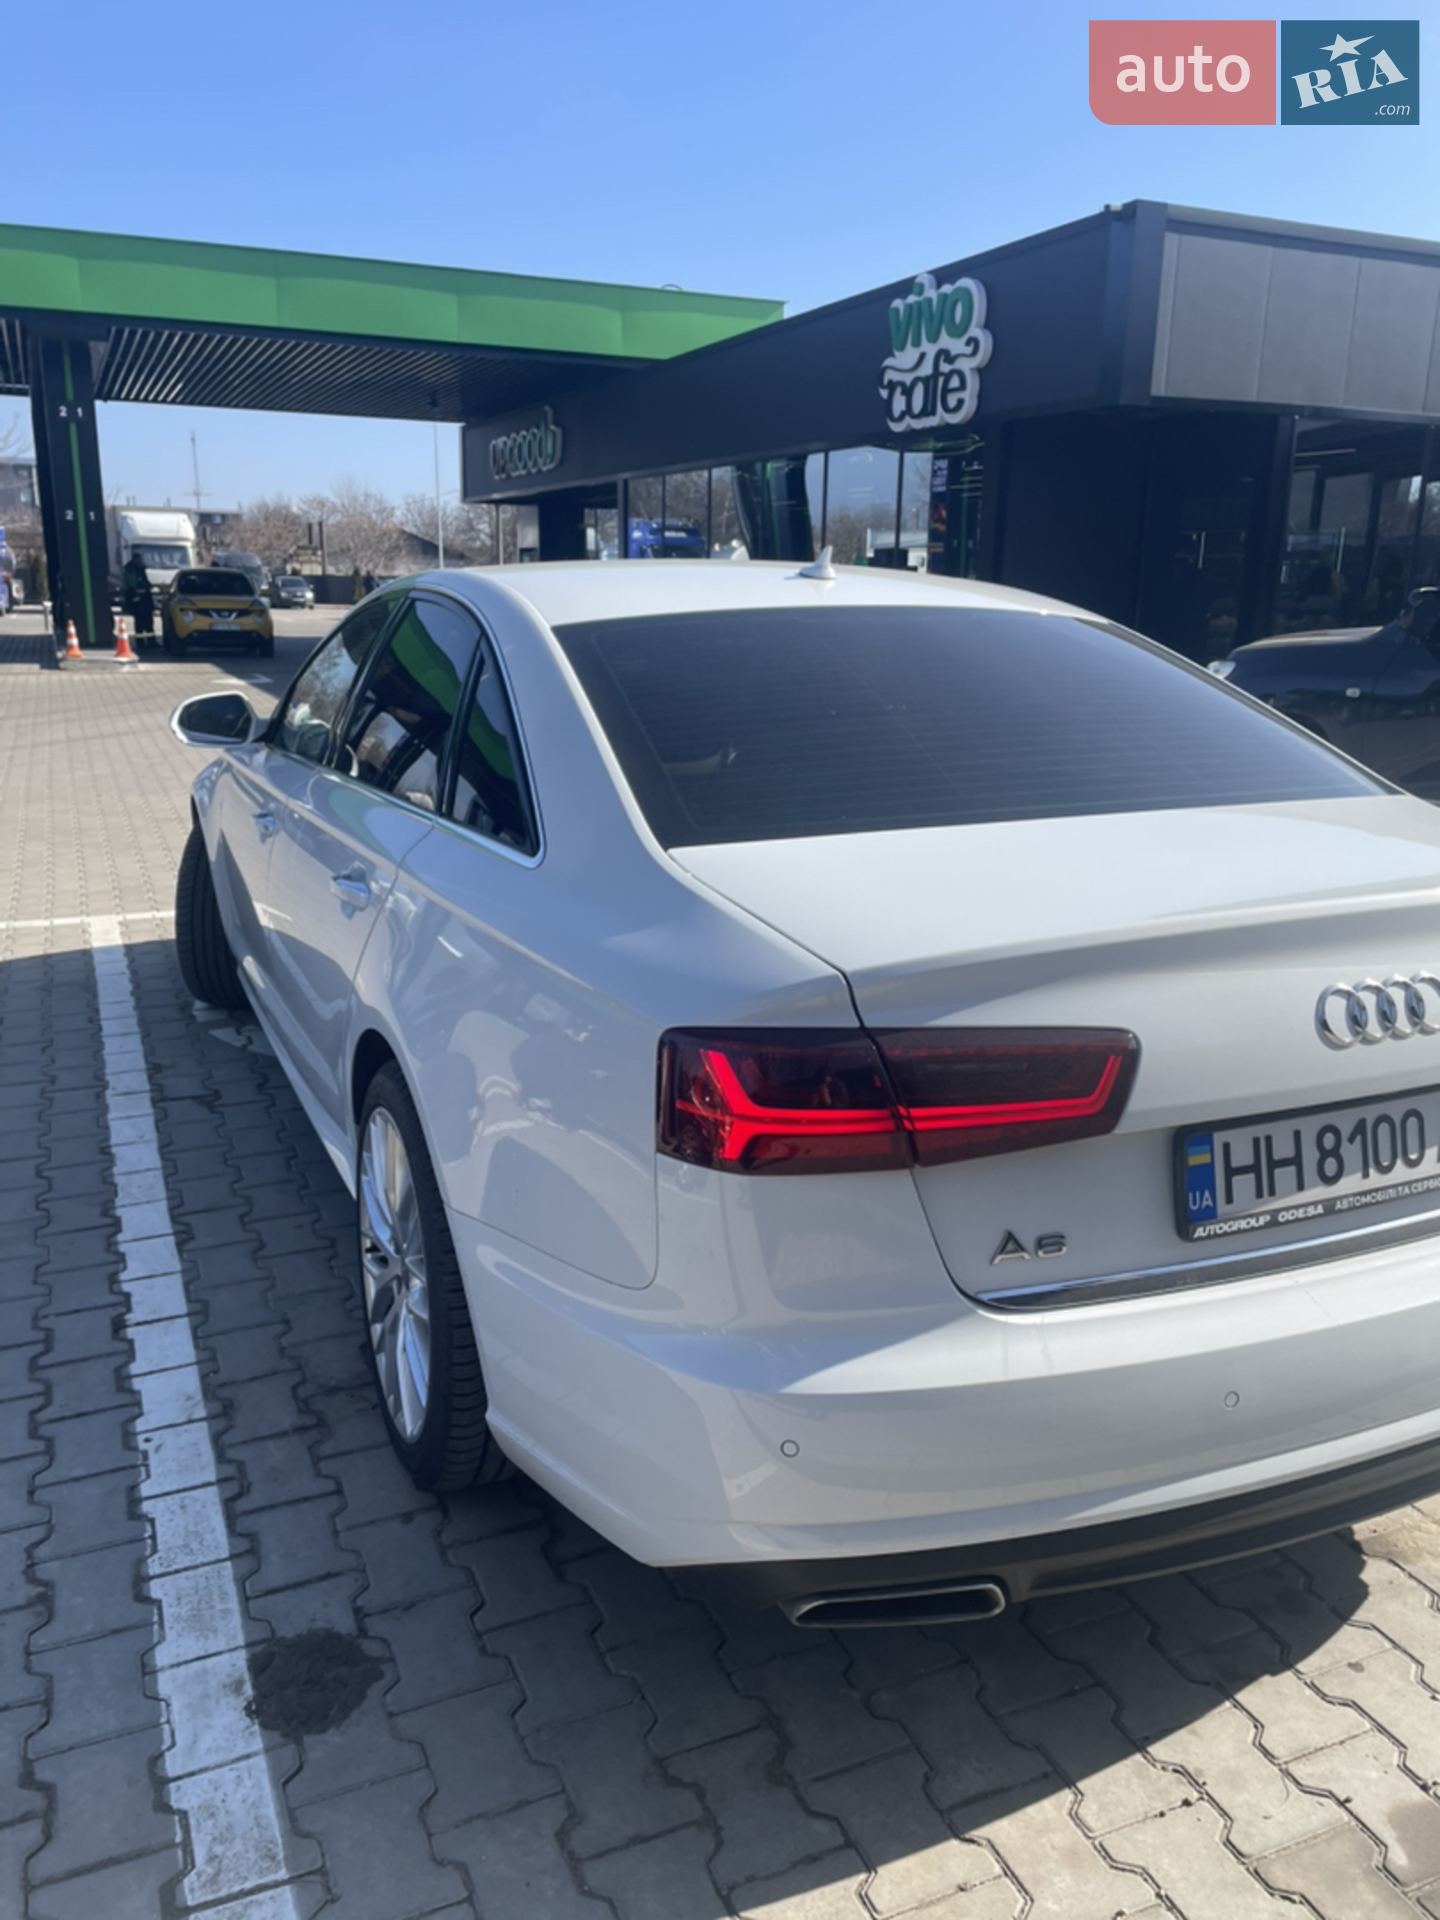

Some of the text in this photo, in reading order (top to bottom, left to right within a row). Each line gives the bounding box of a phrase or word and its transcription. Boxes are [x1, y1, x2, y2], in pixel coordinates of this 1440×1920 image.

[888, 281, 975, 353] vivo
[59, 405, 83, 418] 2 1
[1222, 1128, 1305, 1205] HH
[1316, 1108, 1426, 1187] 8100
[1188, 1189, 1214, 1210] UA
[1193, 1203, 1324, 1239] AUTOGROUP ODESA
[989, 1229, 1068, 1266] A6
